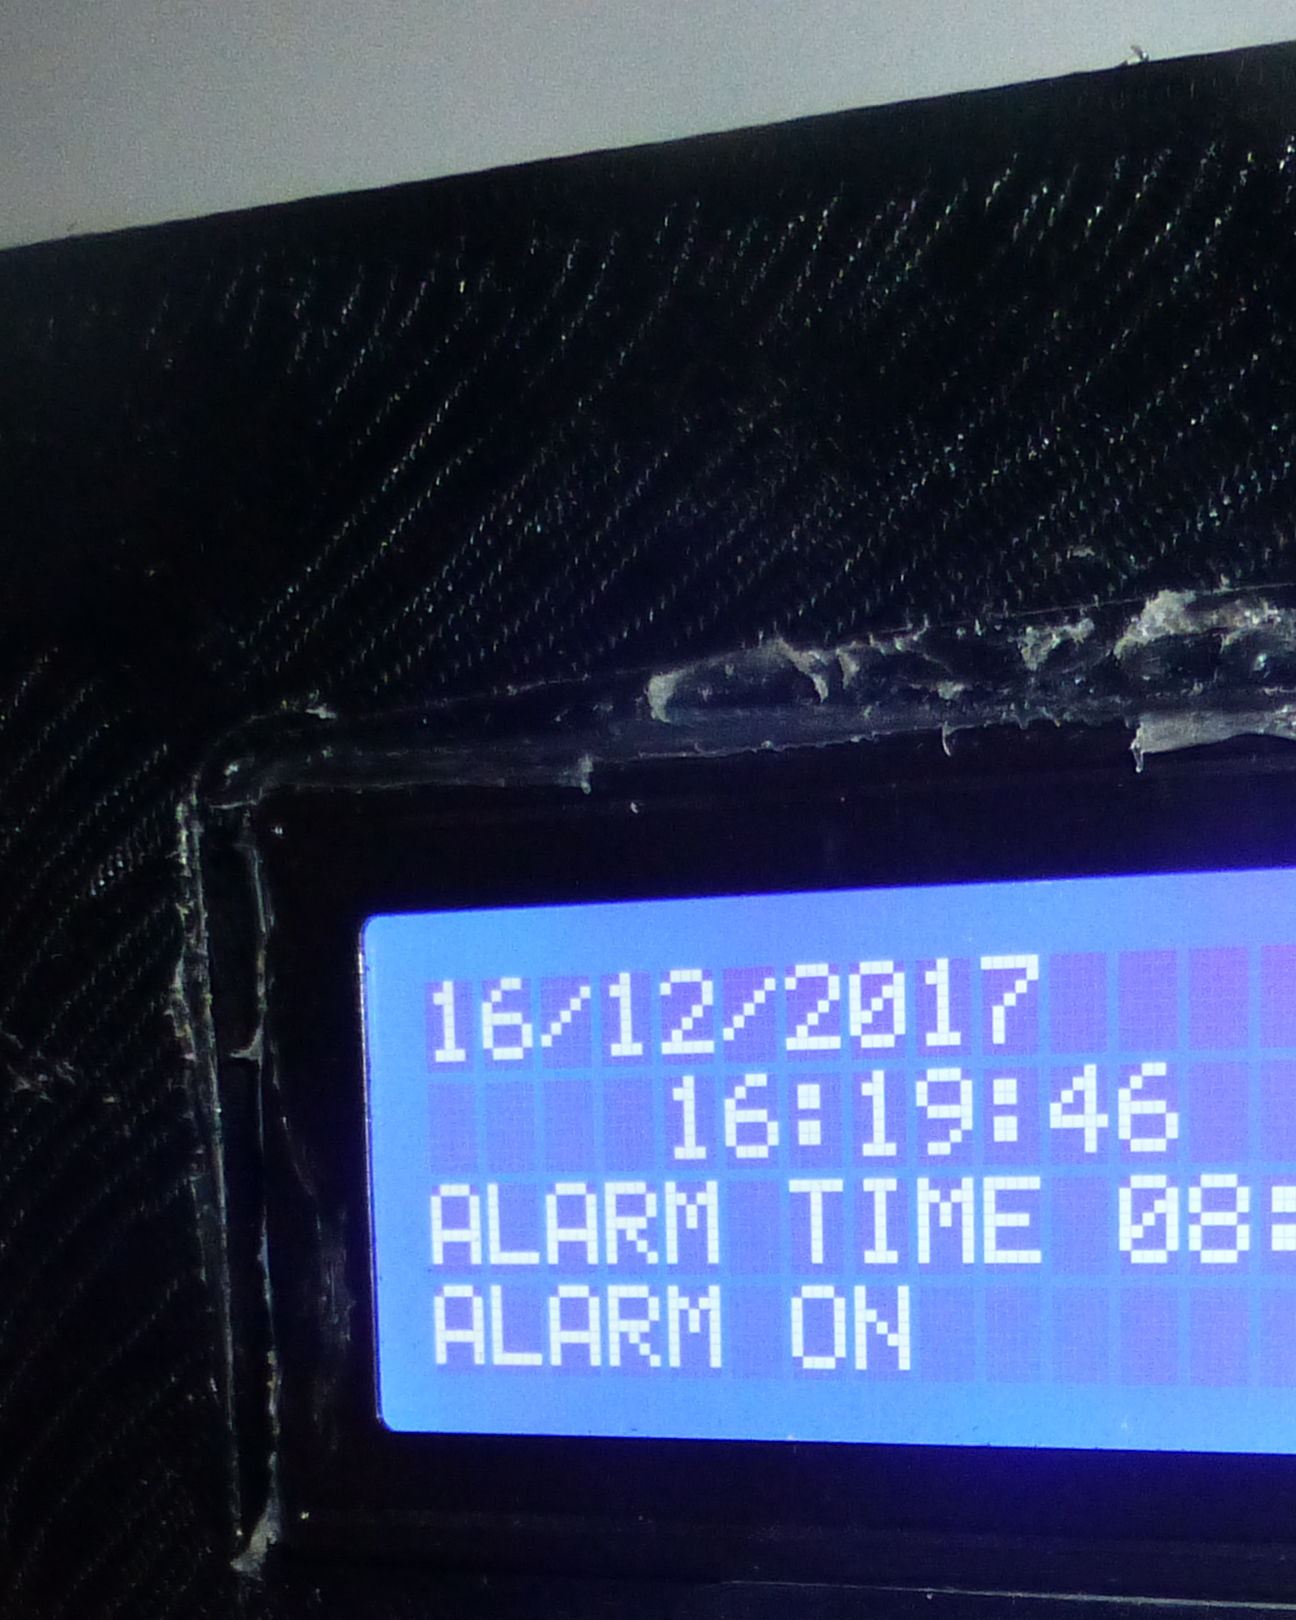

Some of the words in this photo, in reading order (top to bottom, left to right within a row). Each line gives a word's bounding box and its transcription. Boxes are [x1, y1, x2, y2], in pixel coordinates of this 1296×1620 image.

[433, 954, 1039, 1063] 16/12/2017
[671, 1060, 1179, 1160] 16:19:46
[430, 1180, 720, 1265] ALARM
[788, 1175, 1042, 1264] TIME
[434, 1284, 722, 1368] ALARM
[791, 1285, 911, 1371] ON
